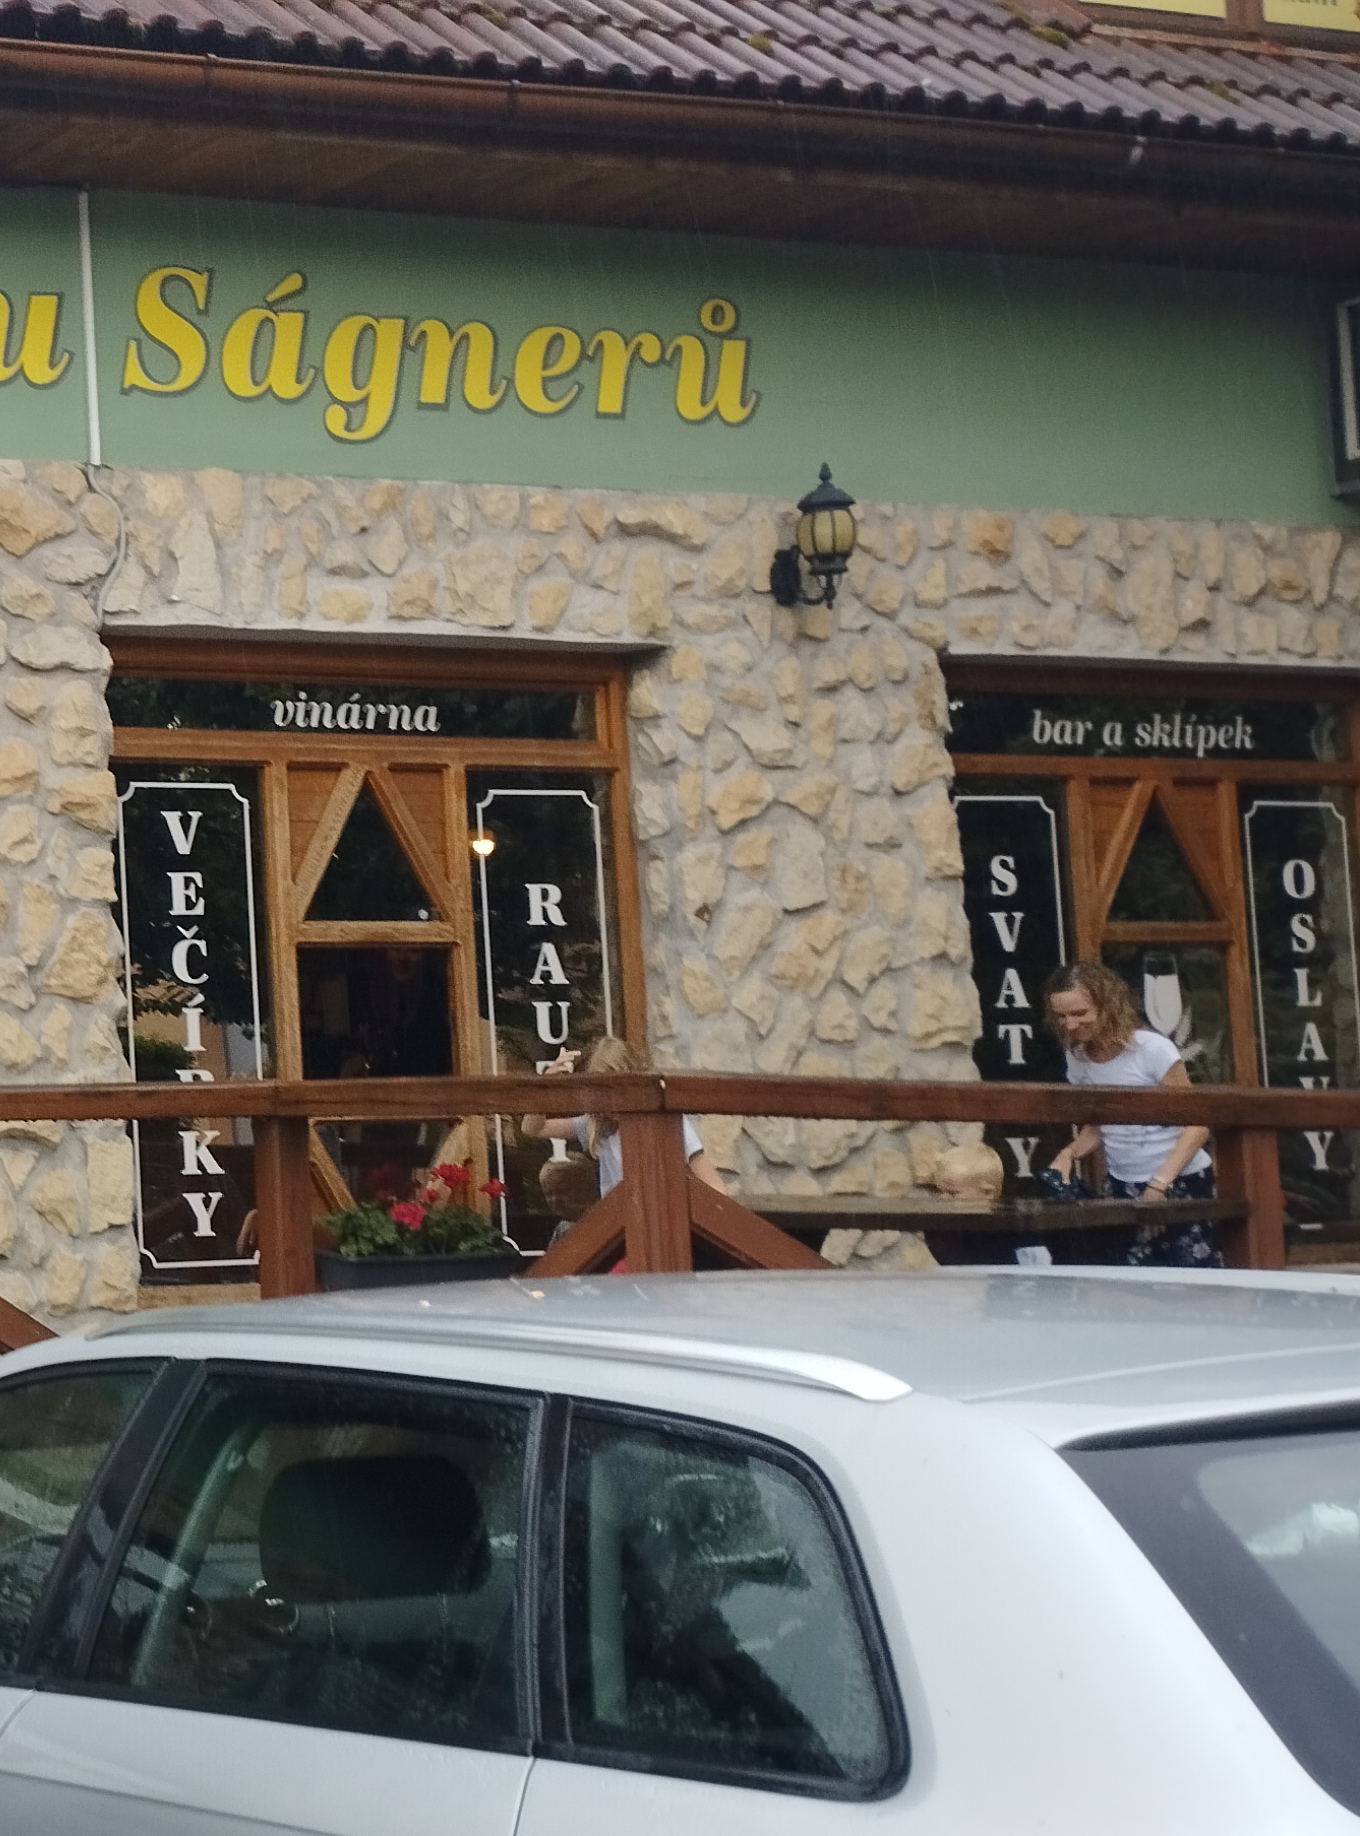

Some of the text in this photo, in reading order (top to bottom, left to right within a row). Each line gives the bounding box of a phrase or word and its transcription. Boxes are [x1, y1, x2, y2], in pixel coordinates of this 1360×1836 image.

[119, 263, 761, 446] Ságnerů
[270, 692, 441, 733] vinárna
[1032, 709, 1254, 758] bar a sklípek
[160, 809, 226, 1239] VEČÍKY
[988, 854, 1041, 1179] SVATY
